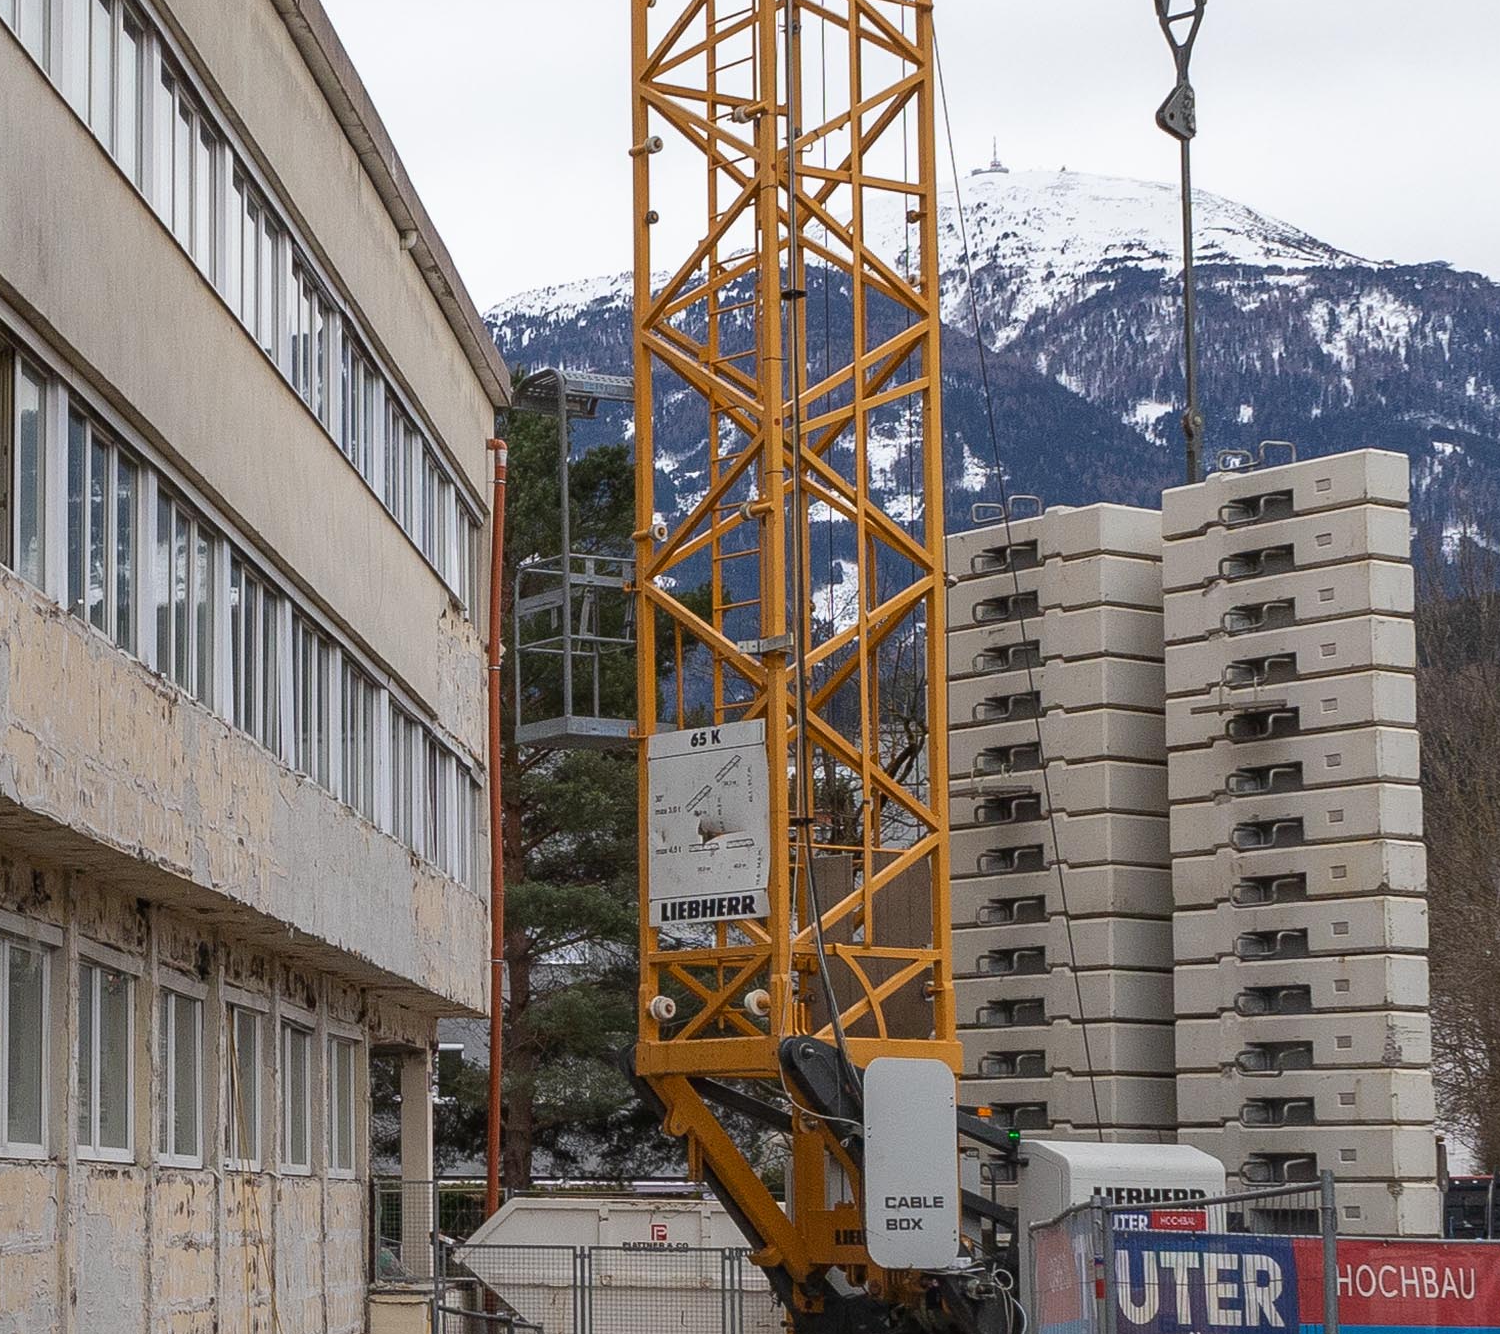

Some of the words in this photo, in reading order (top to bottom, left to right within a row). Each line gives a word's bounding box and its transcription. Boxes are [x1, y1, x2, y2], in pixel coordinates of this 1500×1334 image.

[690, 731, 707, 747] 65
[711, 729, 721, 745] K
[660, 894, 757, 922] LIEBHERR
[885, 1196, 944, 1209] CABLE
[886, 1218, 923, 1231] BOX
[1114, 1249, 1286, 1328] UTER
[1337, 1264, 1476, 1300] HOCHBAU
